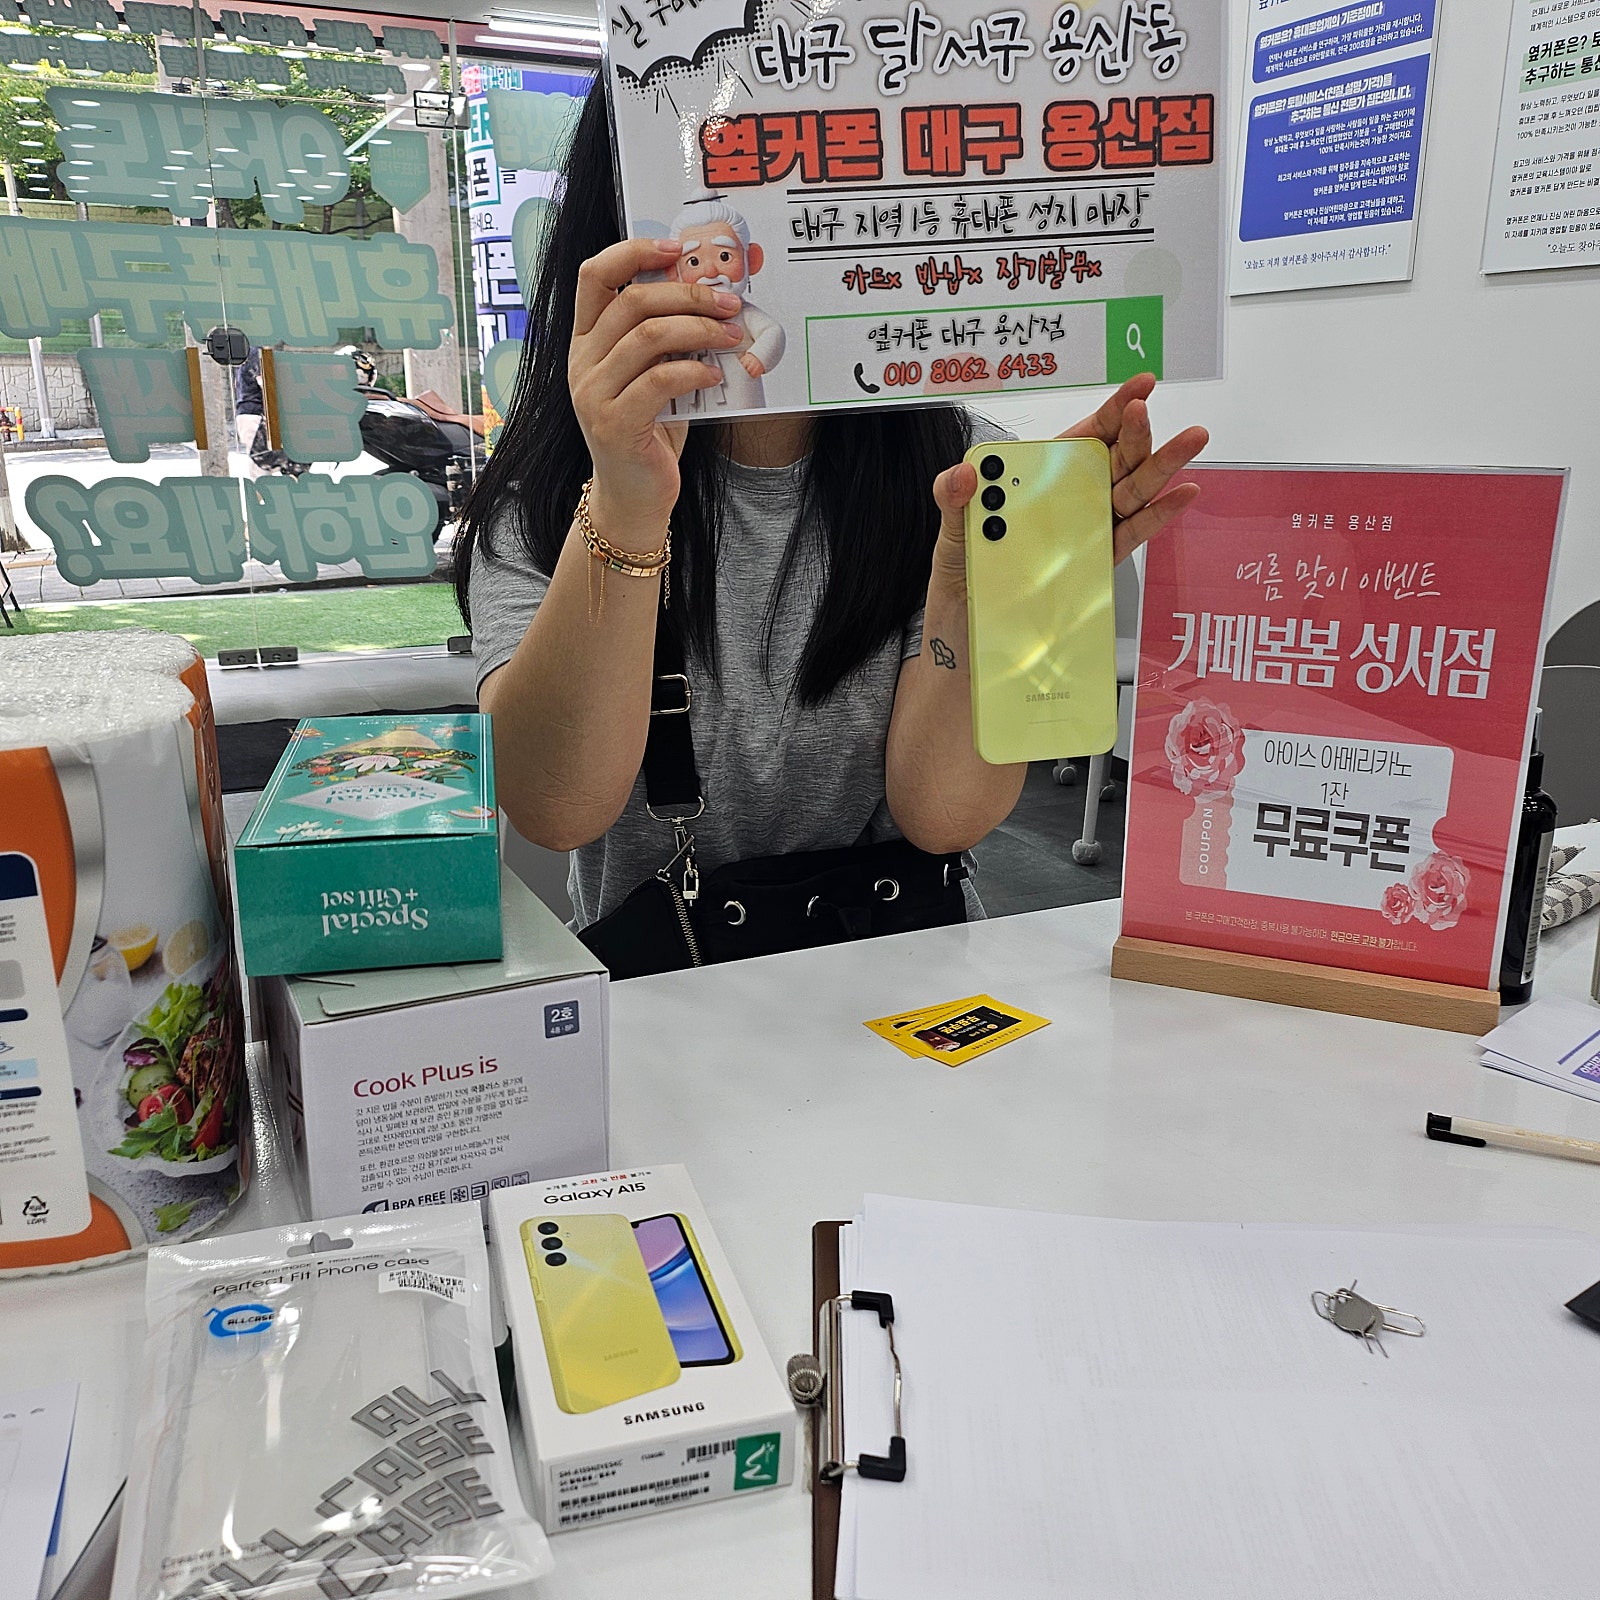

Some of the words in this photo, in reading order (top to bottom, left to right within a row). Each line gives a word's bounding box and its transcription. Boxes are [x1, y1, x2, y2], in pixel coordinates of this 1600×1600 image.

[755, 22, 853, 85] 대구
[868, 4, 1030, 90] 달서구
[1048, 3, 1186, 82] 용산동
[1528, 35, 1588, 63] 옆커폰은?
[1525, 62, 1576, 85] 추구하는
[702, 109, 883, 187] 옆커폰
[901, 103, 1022, 178] 대구
[1042, 94, 1215, 170] 용산점
[791, 206, 845, 243] 대구
[855, 202, 902, 239] 지역
[911, 204, 940, 238] 1등
[953, 194, 1020, 237] 휴대폰
[1027, 192, 1077, 233] 성지
[1086, 186, 1148, 230] 매장
[867, 316, 933, 352] 옆커폰
[942, 315, 984, 349] 대구
[992, 312, 1066, 348] 용산점
[884, 360, 922, 386] 010
[931, 356, 989, 383] 8062
[998, 352, 1058, 379] 6433
[1291, 513, 1335, 531] 옆커폰
[1348, 514, 1394, 533] 용산점
[1236, 553, 1284, 602] 여름
[1295, 555, 1347, 600] 맞이
[1359, 560, 1442, 600] 이벤트
[1167, 612, 1341, 688] 카페봄봄
[1349, 623, 1497, 700] 성서점
[1025, 690, 1071, 703] SAMSUNG
[1264, 739, 1317, 769] 아이스
[1320, 744, 1413, 778] 아메리카노
[1321, 781, 1350, 808] 1잔
[1199, 807, 1213, 875] COUPON
[1253, 802, 1412, 873] 무료쿠폰
[322, 907, 429, 937] Special
[551, 1006, 575, 1023] 2호
[353, 1072, 417, 1098] Cook
[422, 1063, 474, 1086] Plus
[479, 1055, 498, 1076] is
[392, 1198, 416, 1211] BPA
[418, 1190, 447, 1206] FREE
[543, 1186, 615, 1205] Galaxy
[617, 1182, 647, 1195] A15
[213, 1274, 284, 1296] Perfect
[290, 1270, 311, 1284] Fit
[318, 1260, 379, 1279] Phone
[384, 1257, 431, 1267] case
[351, 1369, 487, 1438] ALL
[623, 1402, 706, 1426] SAMSUNG
[314, 1412, 495, 1519] CASE
